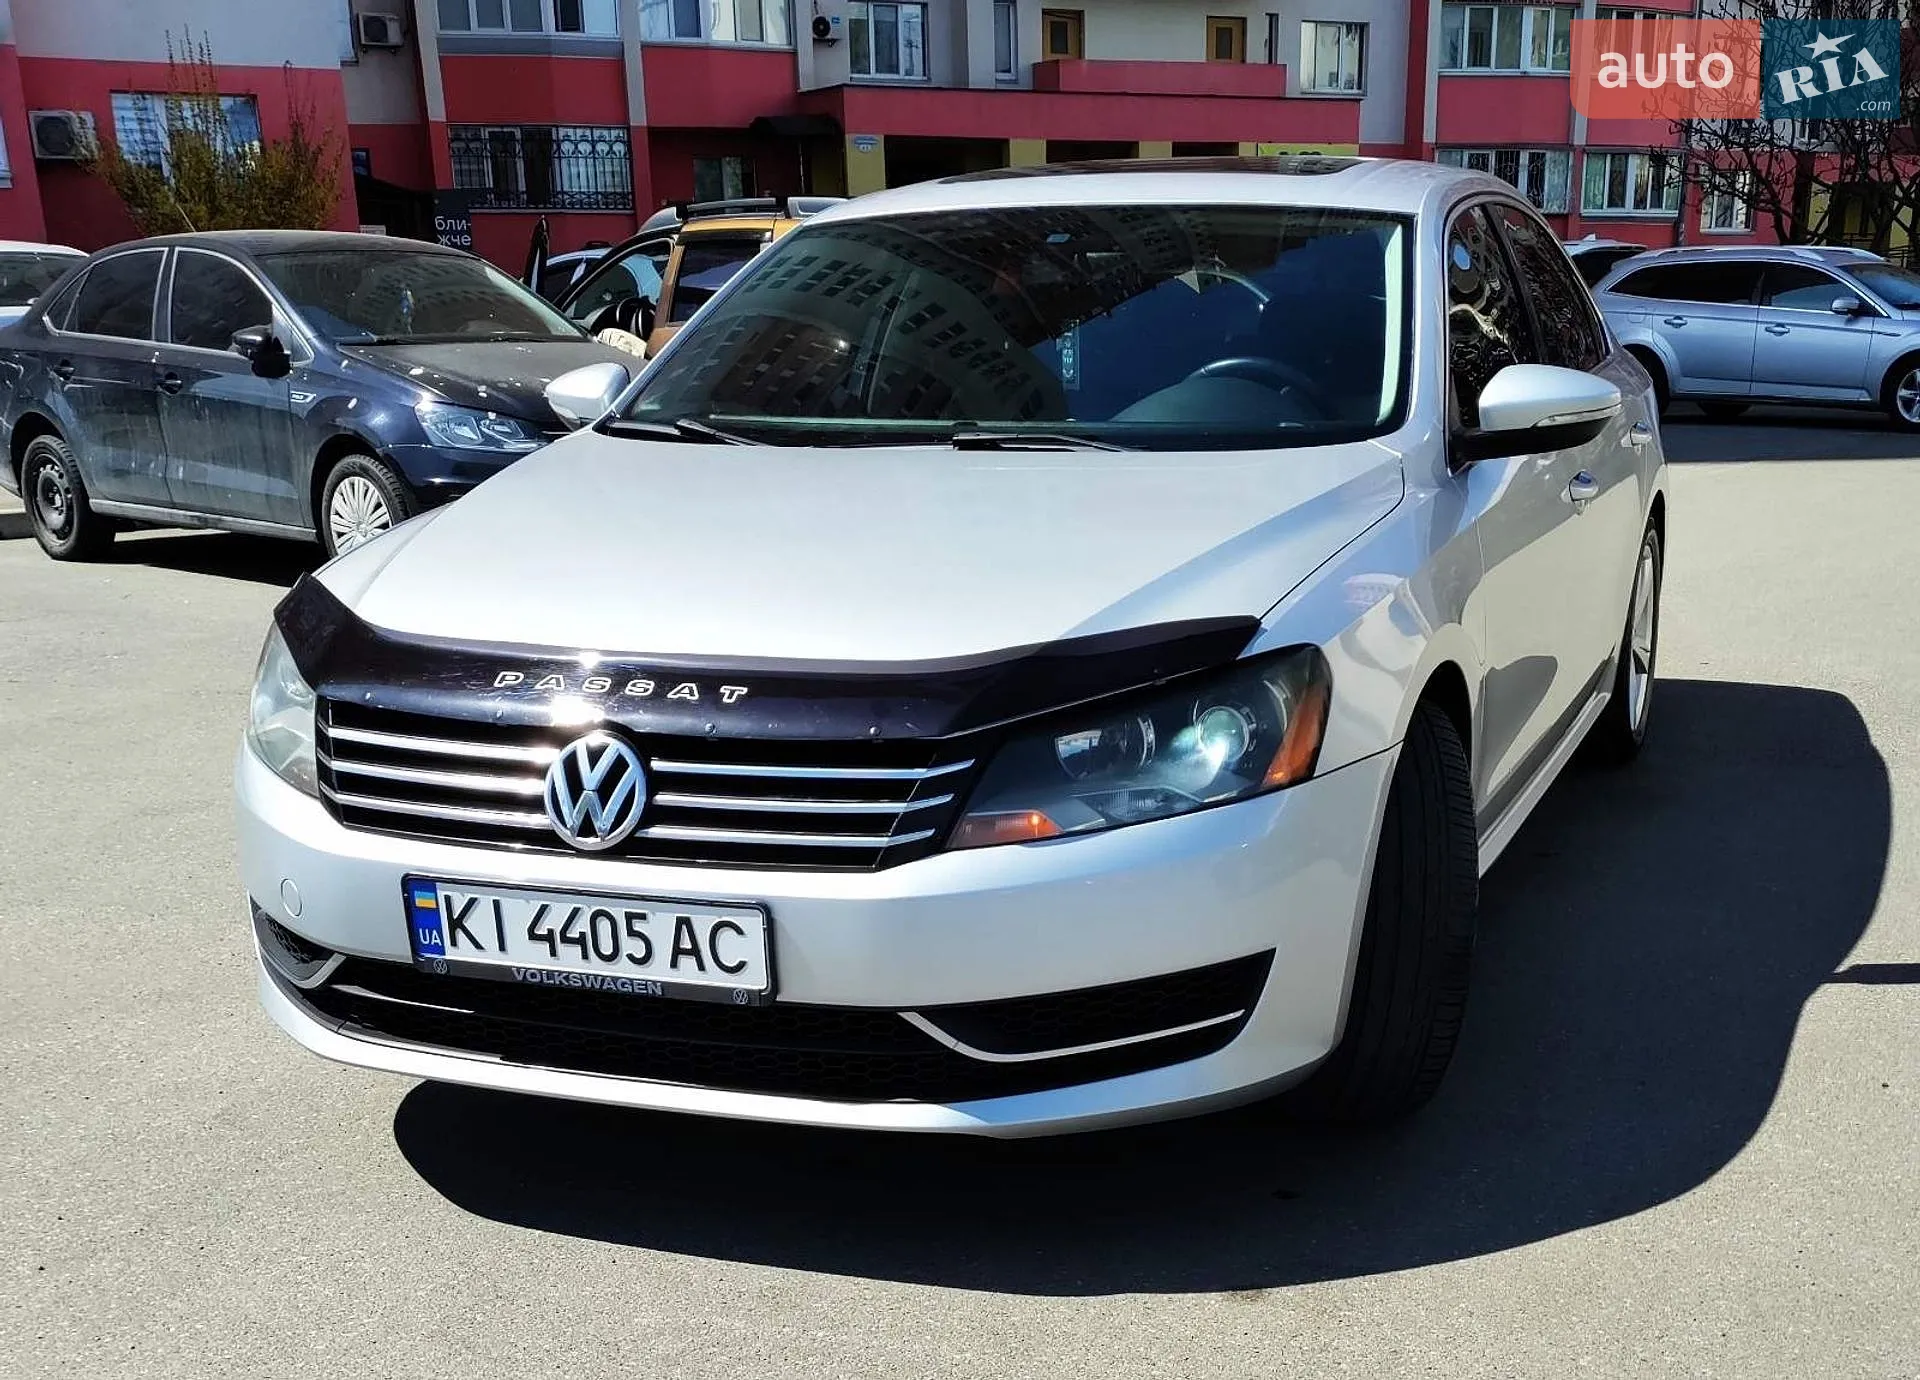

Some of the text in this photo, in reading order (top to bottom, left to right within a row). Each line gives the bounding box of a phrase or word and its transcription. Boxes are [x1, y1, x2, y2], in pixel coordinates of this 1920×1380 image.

[435, 216, 471, 230] бли-
[437, 235, 471, 246] жче
[494, 671, 748, 703] PASSAT
[419, 927, 442, 946] UA
[443, 894, 748, 975] KI 4405 AC
[511, 967, 663, 997] VOLKSWAGEN
